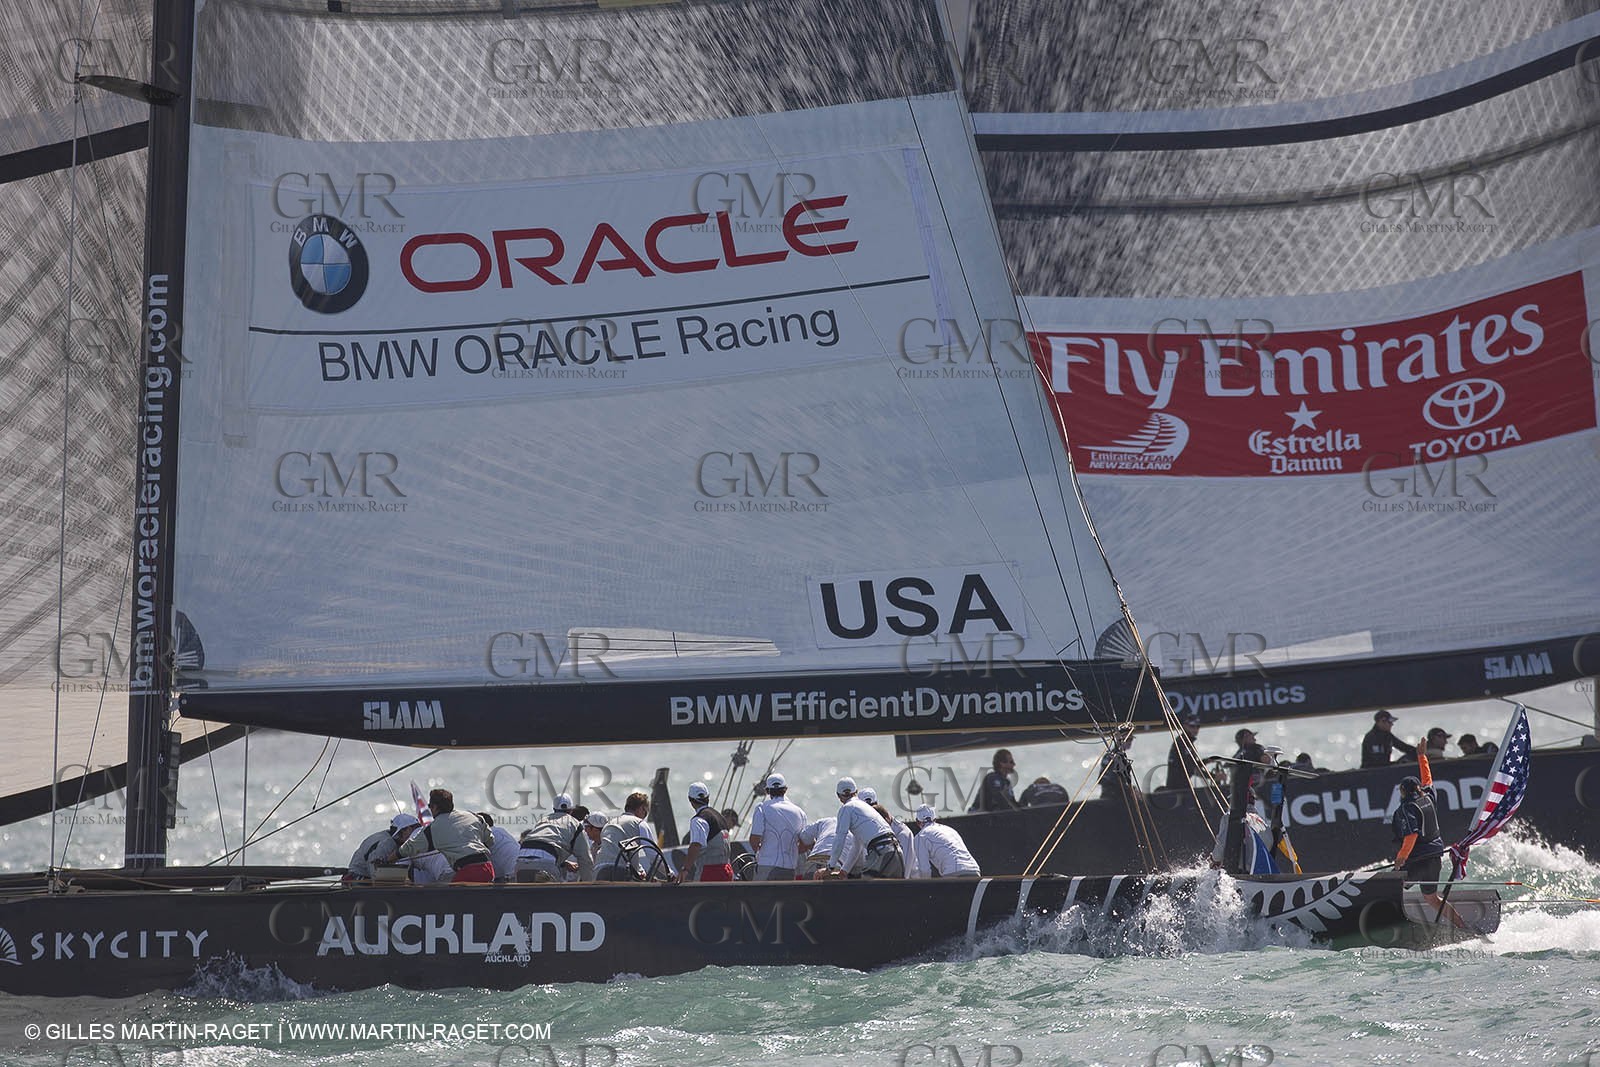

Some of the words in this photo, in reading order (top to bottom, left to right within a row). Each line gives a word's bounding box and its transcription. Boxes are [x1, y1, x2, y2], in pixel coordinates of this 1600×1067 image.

[294, 217, 358, 249] BMW
[400, 195, 859, 293] ORACLE
[318, 338, 439, 382] BMW
[455, 320, 666, 375] ORACLE
[676, 307, 841, 355] Racing
[1047, 336, 1179, 409] Fly
[1200, 304, 1545, 397] Emirates
[1248, 429, 1361, 456] Estrella
[1409, 424, 1522, 460] TOYOTA
[131, 274, 169, 688] bmworacleracing.com
[1089, 462, 1117, 470] NEW
[1118, 462, 1172, 470] ZEALAND
[1270, 454, 1344, 474] Damm
[820, 574, 1014, 639] USA
[1484, 652, 1553, 680] SLAM
[363, 700, 445, 730] SLAM
[669, 694, 763, 727] BMW
[771, 685, 1084, 725] EfficientDynamics
[1165, 683, 1307, 715] Dynamics
[31, 929, 209, 960] SKYCITY
[316, 911, 606, 957] AUCKLAND
